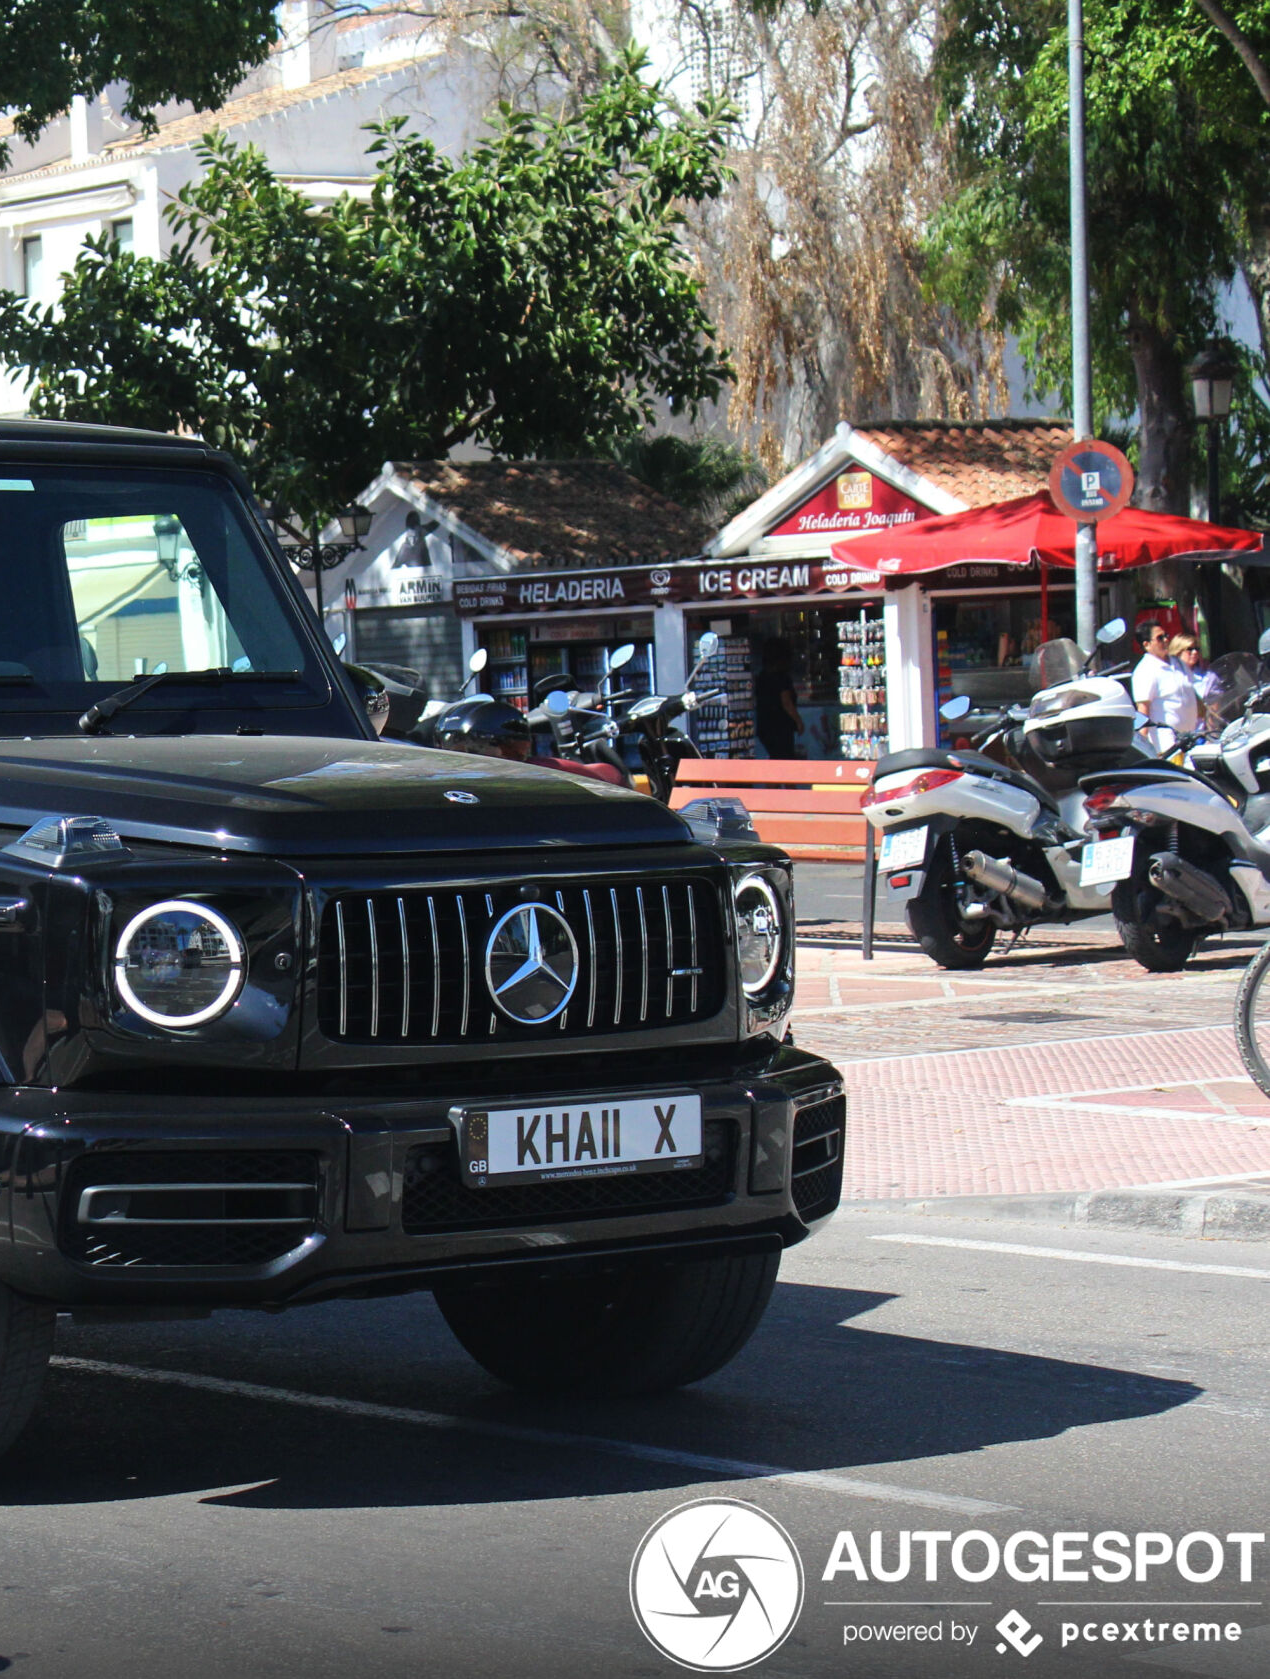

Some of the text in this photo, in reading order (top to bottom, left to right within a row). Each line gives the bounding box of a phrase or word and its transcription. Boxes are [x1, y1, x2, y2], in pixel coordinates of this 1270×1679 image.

[840, 482, 870, 494] CARTE
[1086, 474, 1096, 489] P
[699, 570, 732, 594] ICE
[737, 564, 810, 592] CREAM
[825, 571, 881, 586] COLD DRINKS
[946, 566, 967, 578] COLD
[970, 566, 999, 578] DRINKS
[399, 578, 441, 594] ARMIN
[520, 577, 625, 603] HELADERIA
[459, 595, 505, 608] COLD DRINKS
[653, 1104, 677, 1154] X
[469, 1159, 487, 1173] GB
